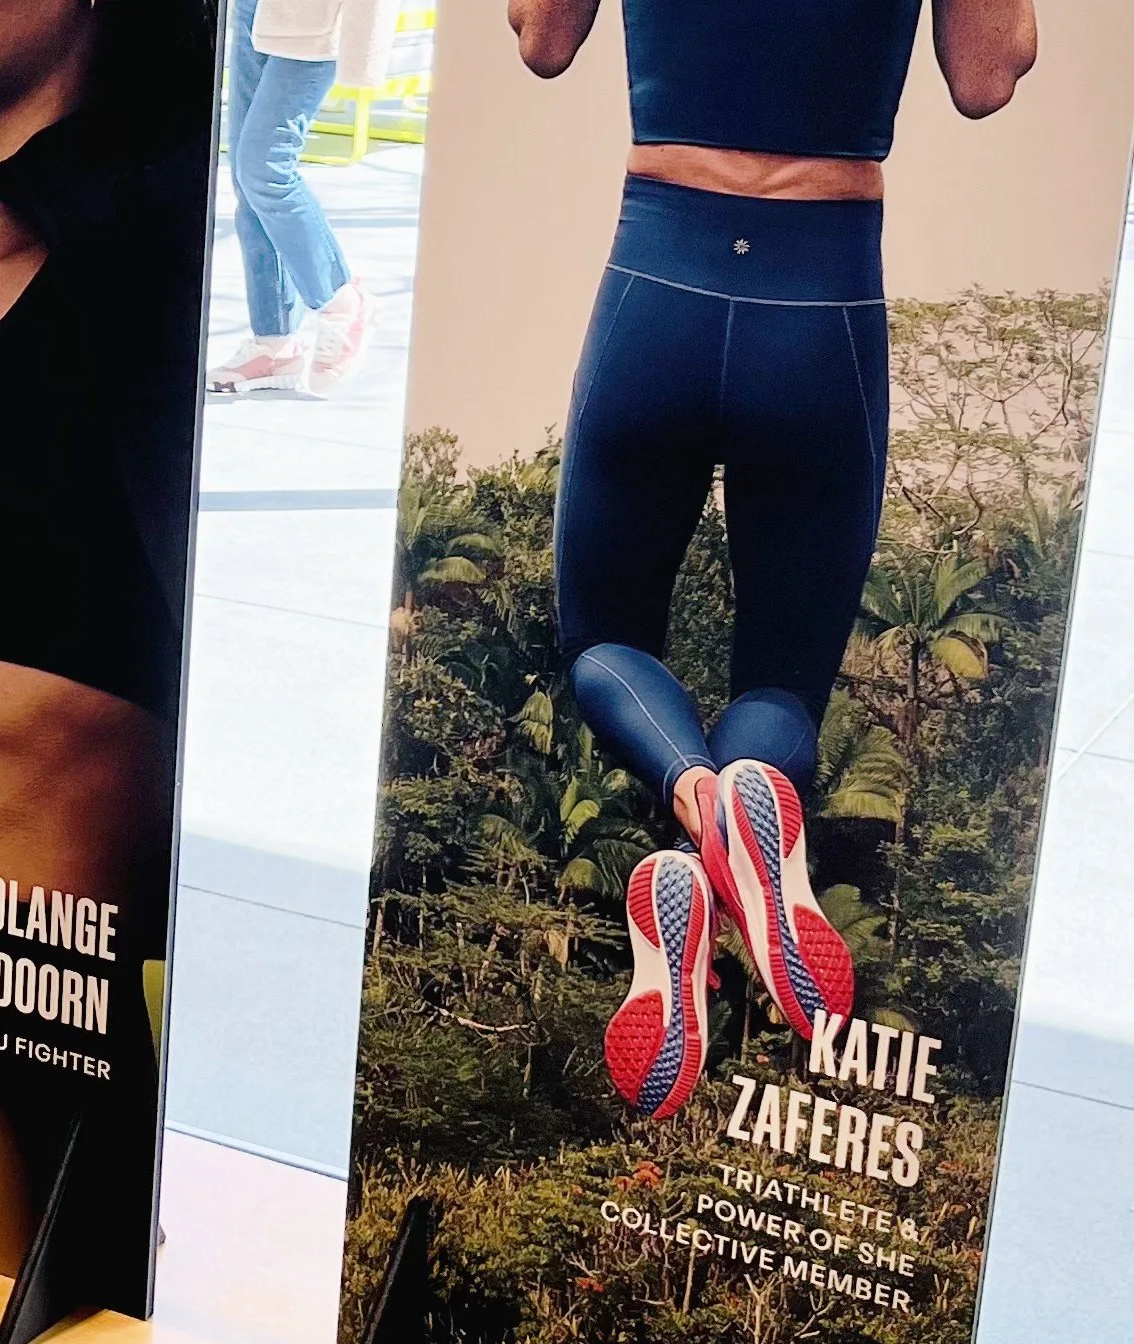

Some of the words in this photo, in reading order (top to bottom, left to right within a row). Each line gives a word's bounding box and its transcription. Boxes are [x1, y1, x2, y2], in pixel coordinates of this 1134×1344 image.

[15, 1036, 112, 1080] FIGHTER
[808, 1008, 943, 1104] KATIE
[726, 1074, 925, 1188] ZAFERES
[696, 1194, 800, 1245] POWER
[809, 1229, 849, 1257] OF
[858, 1241, 916, 1279] SHE
[718, 1163, 894, 1234] TRIATHLETE
[901, 1218, 920, 1242] &
[600, 1201, 775, 1271] COLLECTIVE
[781, 1257, 911, 1313] MEMBER
